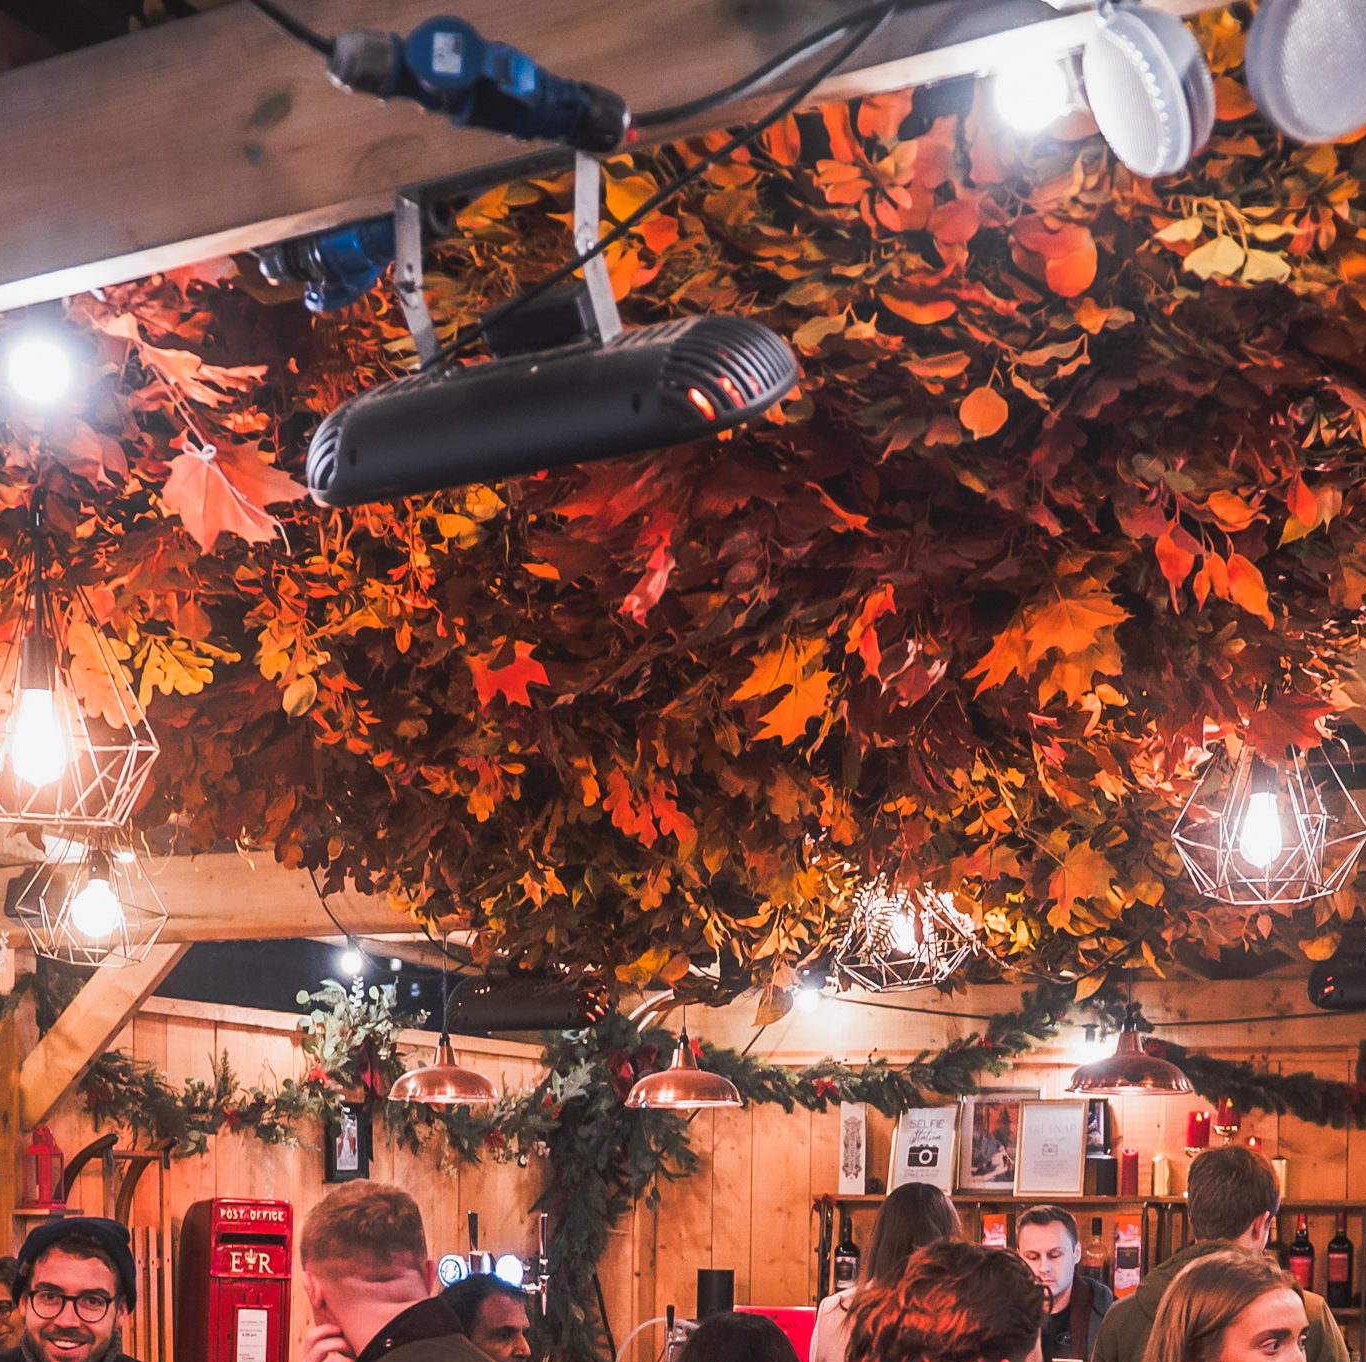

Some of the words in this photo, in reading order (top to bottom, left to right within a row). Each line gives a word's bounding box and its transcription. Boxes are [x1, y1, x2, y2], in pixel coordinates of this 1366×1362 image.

[909, 1119, 945, 1129] SELFIE
[1029, 1124, 1044, 1135] OH
[1048, 1124, 1077, 1135] SNAP
[220, 1208, 245, 1220] POST
[250, 1209, 284, 1222] OFFICE
